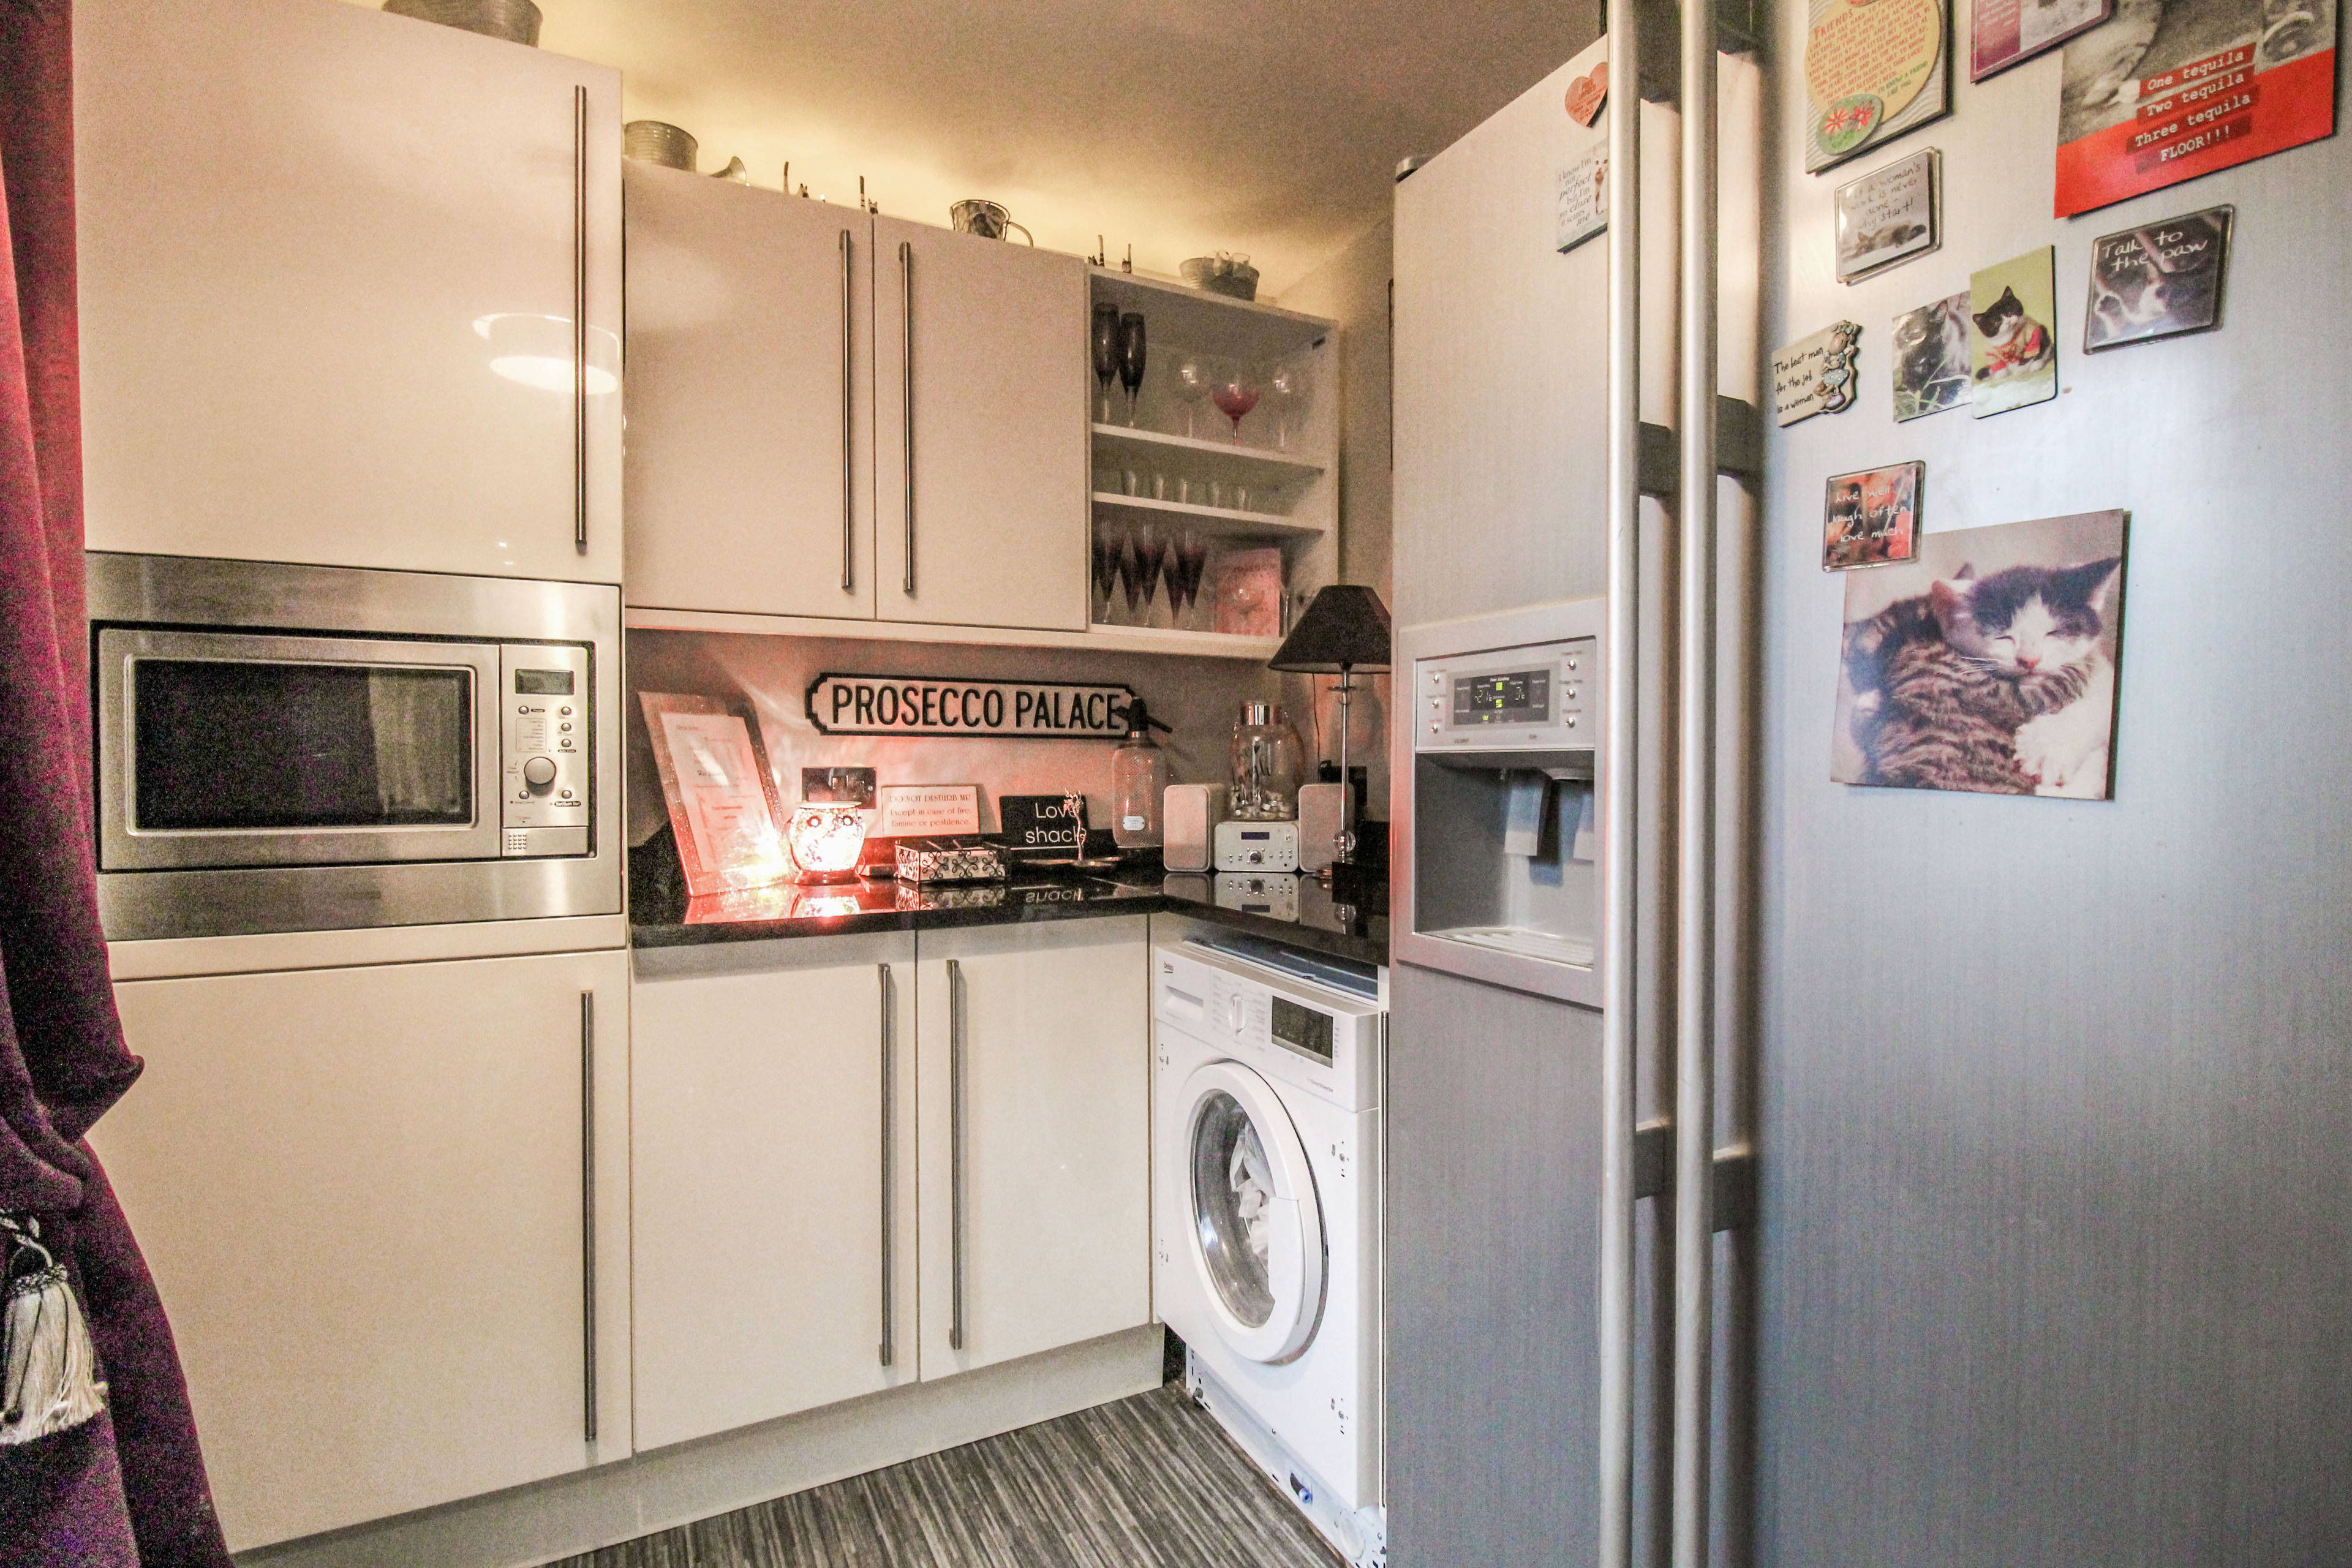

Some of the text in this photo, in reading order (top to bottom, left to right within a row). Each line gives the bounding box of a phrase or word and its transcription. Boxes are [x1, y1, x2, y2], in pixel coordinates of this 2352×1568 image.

[1814, 9, 1853, 40] FRIENDS
[2147, 51, 2245, 91] One tequila
[2146, 72, 2245, 117] Two tequila
[2135, 92, 2252, 148] Three tequila
[2160, 126, 2230, 162] FLOOR!!!
[1562, 164, 1580, 179] know
[1879, 161, 1921, 185] woman's
[1559, 172, 1591, 201] perfect
[1891, 178, 1917, 194] never
[1569, 195, 1591, 213] close
[2102, 230, 2184, 258] Talk to
[2111, 239, 2208, 271] the paw
[1774, 347, 1823, 374] The best man
[1775, 369, 1813, 394] for the job
[1790, 393, 1814, 409] woman
[1836, 485, 1890, 503] Live well
[1832, 505, 1907, 527] laugh often
[1840, 530, 1864, 542] love
[832, 684, 1121, 730] PROSECCO PALACE
[891, 808, 915, 817] Except
[1035, 802, 1077, 818] Love
